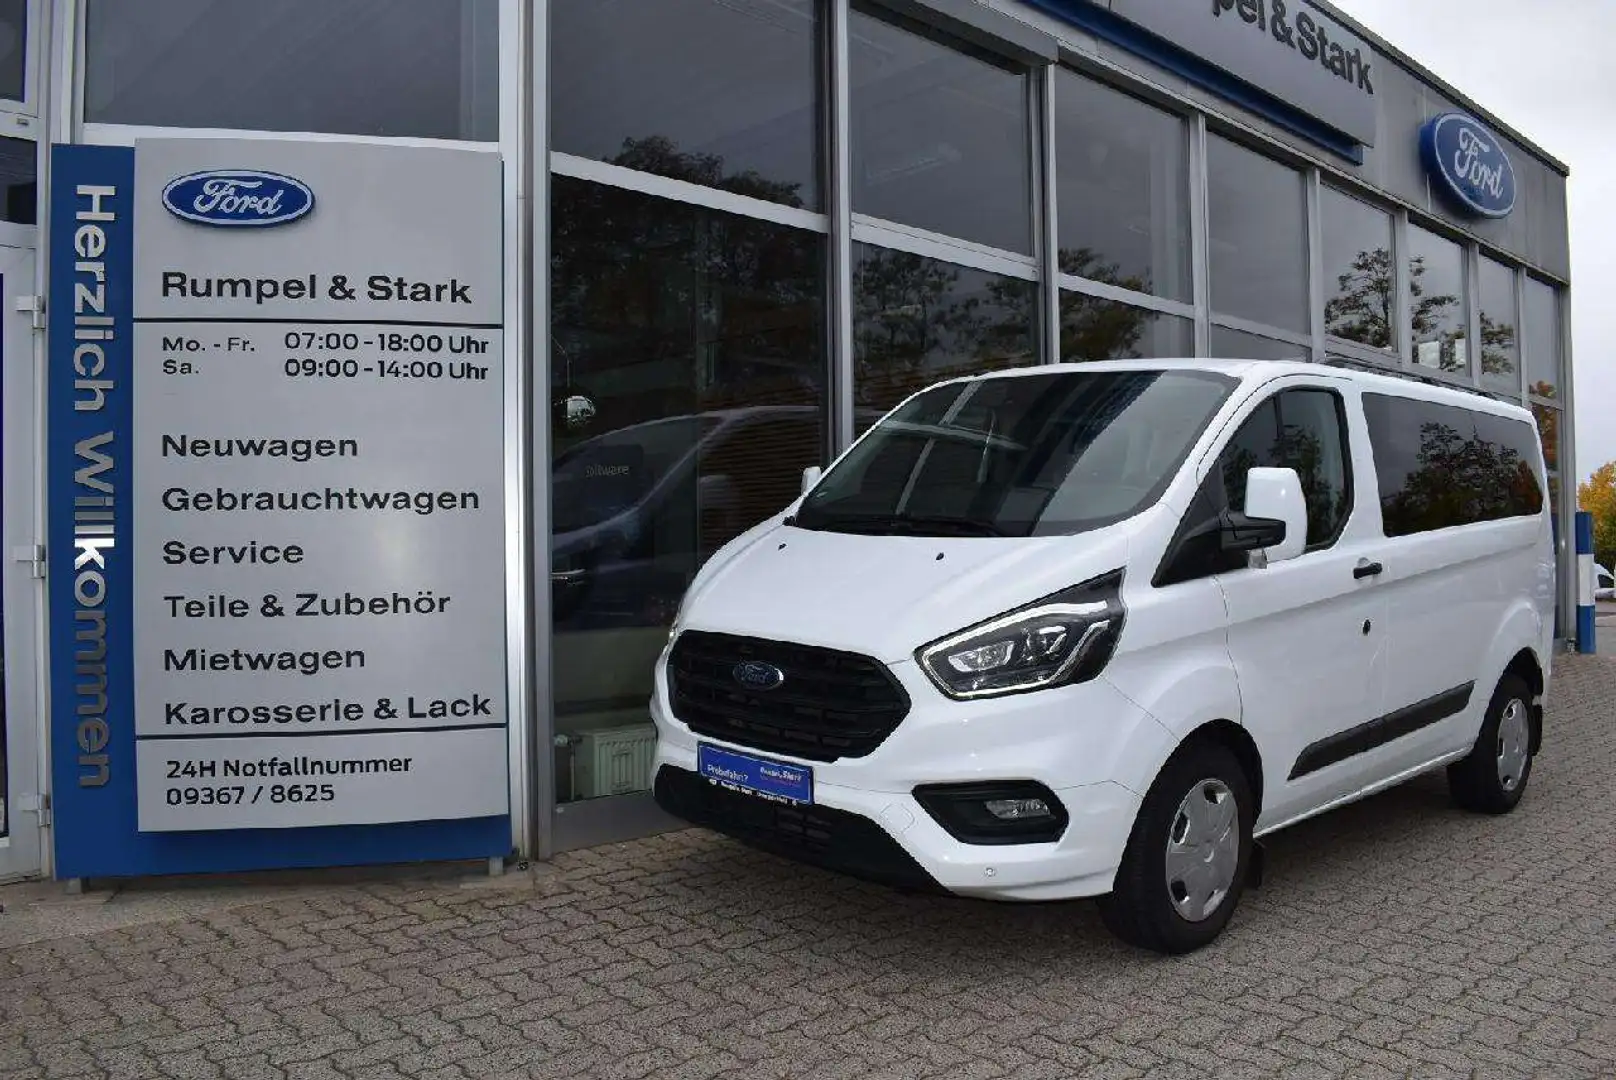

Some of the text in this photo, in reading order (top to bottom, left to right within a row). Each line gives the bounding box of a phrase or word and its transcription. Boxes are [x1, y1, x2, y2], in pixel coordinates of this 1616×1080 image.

[1271, 0, 1296, 49] &
[1296, 12, 1373, 94] Stark
[1454, 127, 1504, 199] Ford
[193, 179, 285, 216] Ford
[162, 271, 473, 304] Rumpel & Stark
[161, 336, 206, 353] Mo.
[227, 336, 255, 352] Fr.
[448, 335, 490, 354] Uhr
[162, 358, 200, 375] Sa.
[448, 362, 489, 380] Uhr
[162, 434, 358, 463] Neuwagen
[73, 184, 116, 789] Herzlich Willkommen
[161, 487, 480, 516] Gebrauchtwagen
[162, 540, 304, 565] Service
[163, 590, 451, 618] Teile & Zubehör
[163, 648, 365, 676] Mietwagen
[165, 693, 492, 725] Karosserie & Lack
[166, 756, 413, 779] 24H Notfallnummer
[166, 785, 245, 806] 09367
[270, 783, 335, 804] 8625
